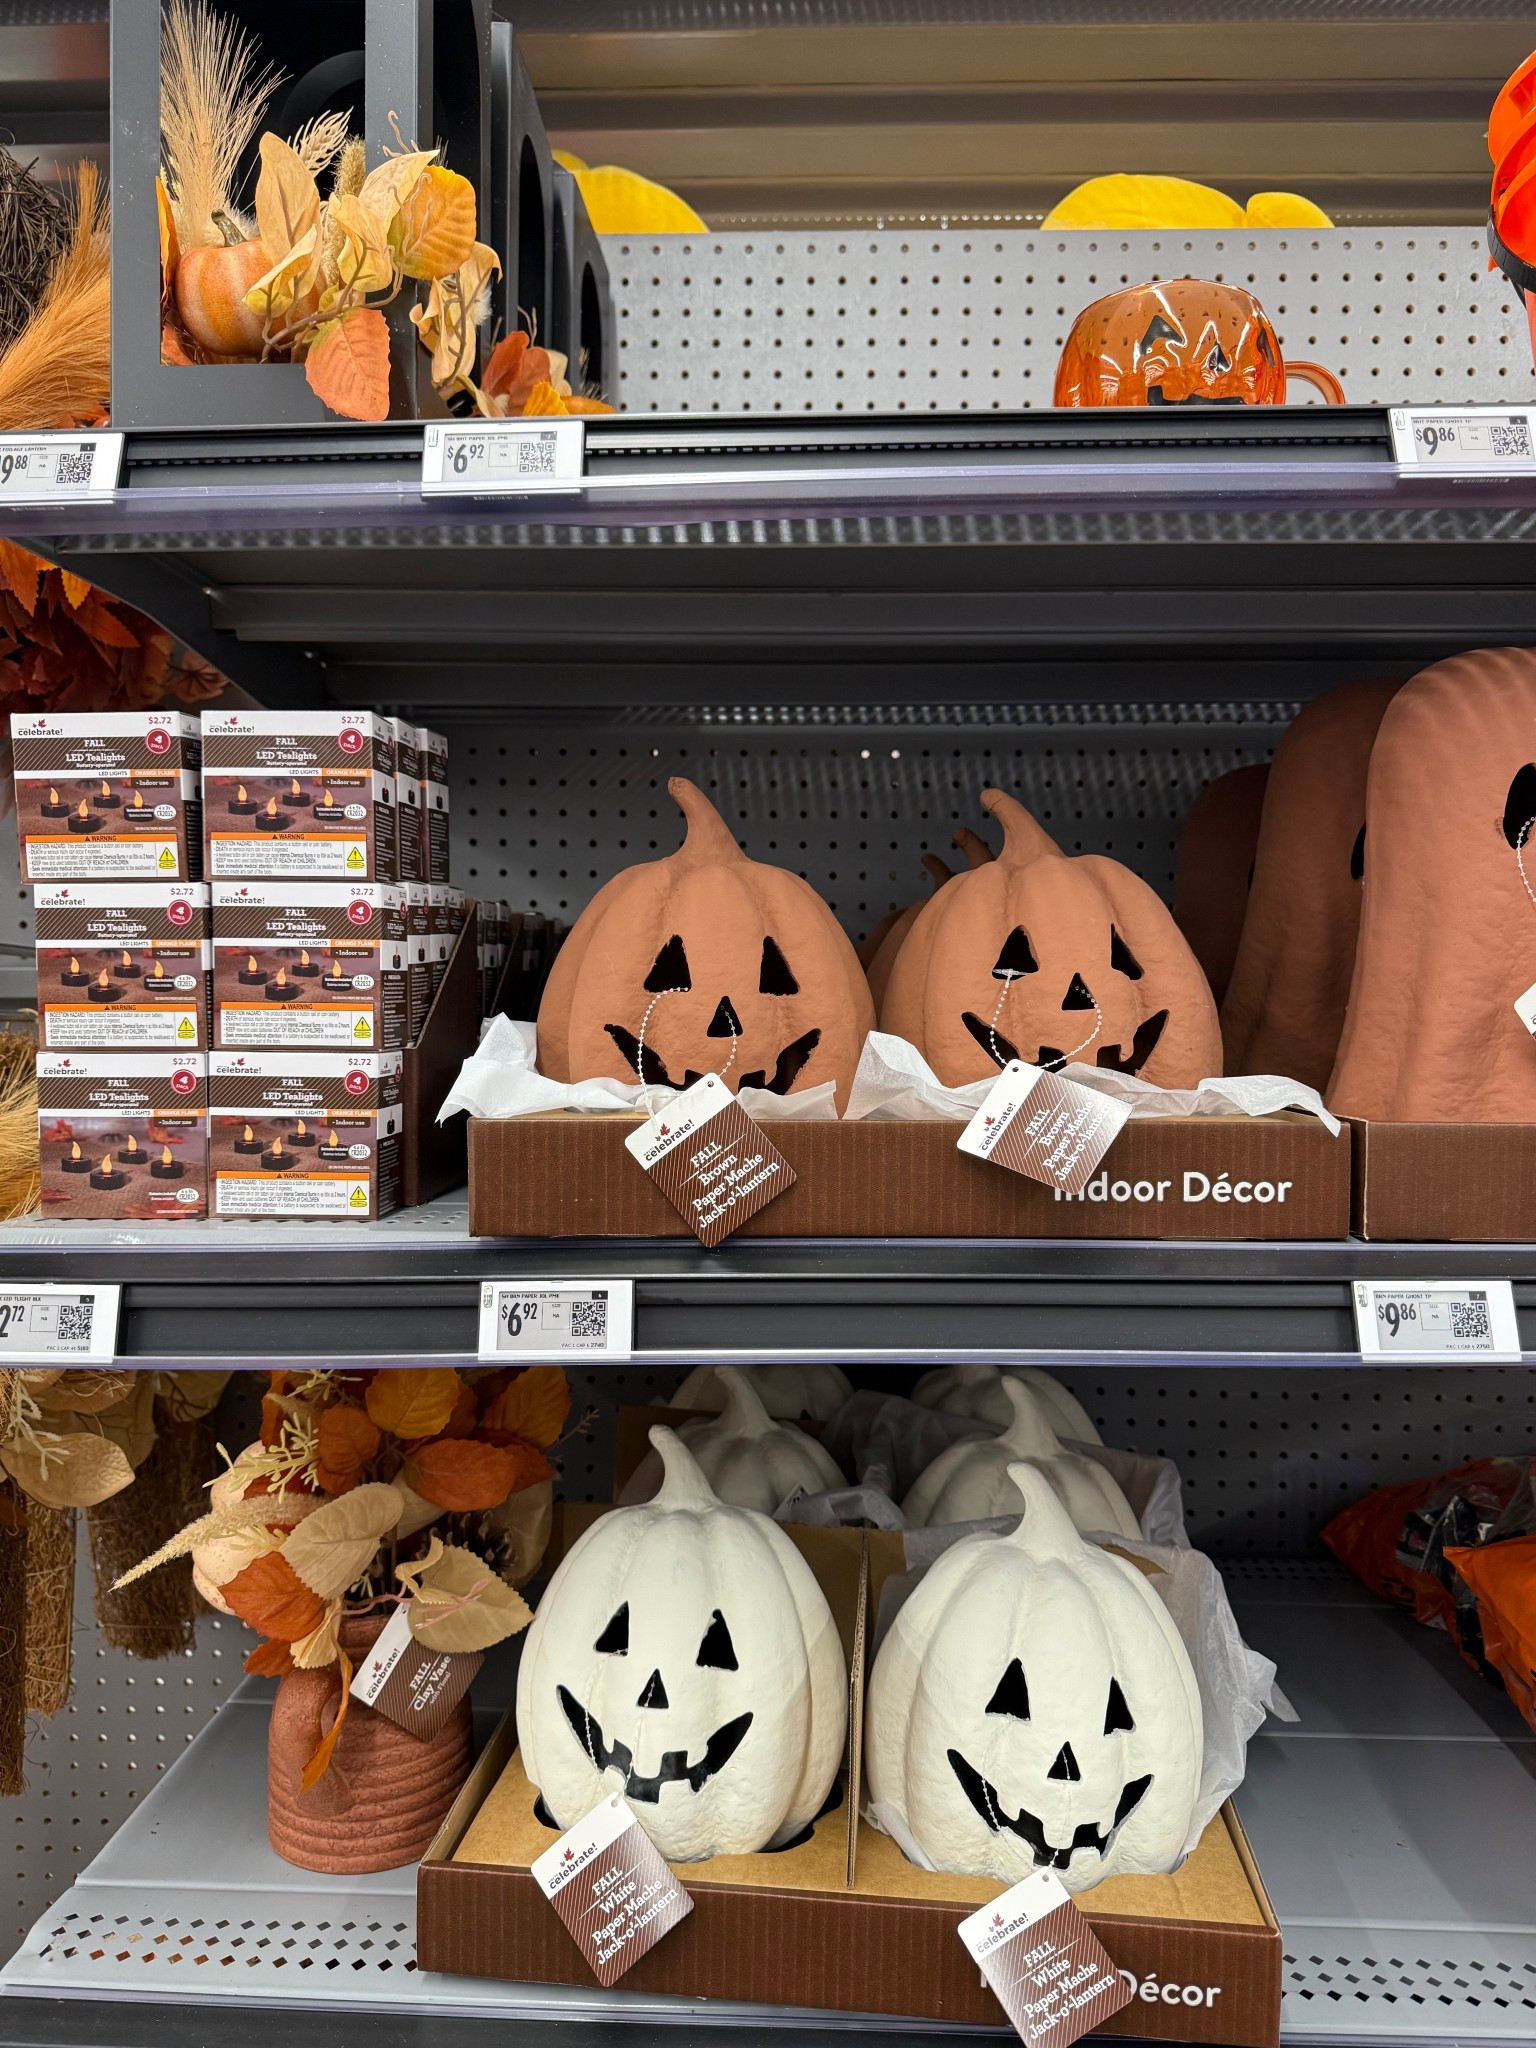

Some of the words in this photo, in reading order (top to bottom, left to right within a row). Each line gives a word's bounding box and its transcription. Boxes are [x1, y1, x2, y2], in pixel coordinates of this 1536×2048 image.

[148, 717, 172, 725] $2.72
[341, 716, 365, 724] $2.72
[17, 728, 63, 736] celebrate!
[84, 739, 106, 747] FALL
[154, 735, 163, 744] 4
[275, 738, 298, 746] FALL
[347, 734, 356, 744] 4
[65, 753, 85, 762] LED
[85, 753, 126, 763] Tealights
[256, 751, 275, 760] LED
[276, 751, 318, 762] Tealights
[170, 888, 194, 896] $2.72
[350, 888, 374, 896] $2.72
[41, 898, 85, 906] celebrate!
[175, 906, 185, 915] 4
[356, 906, 365, 915] 4
[87, 924, 106, 932] LED
[106, 923, 147, 933] Tealights
[266, 922, 285, 930] LED
[286, 922, 327, 932] Tealights
[172, 1058, 197, 1066] $2.72
[348, 1058, 372, 1066] $2.72
[216, 1066, 261, 1074] celebrate!
[107, 1079, 130, 1087] FALL
[179, 1075, 188, 1085] 4
[353, 1076, 362, 1085] 4
[88, 1093, 107, 1101] LED
[108, 1092, 150, 1102] Tealights
[262, 1092, 281, 1100] LED
[282, 1092, 323, 1102] Tealights
[980, 1102, 1017, 1151] celebrate!
[1024, 1109, 1050, 1137] FALL
[1038, 1111, 1070, 1147] Brown
[645, 1118, 695, 1162] celebrate!
[1042, 1136, 1071, 1169] Paper
[1064, 1101, 1095, 1137] Mache
[690, 1141, 722, 1168] FALL
[697, 1154, 738, 1187] Brown
[692, 1180, 727, 1212] Paper
[724, 1153, 764, 1188] Mache
[1183, 1171, 1293, 1203] Décor
[368, 1648, 400, 1699] celebrate!
[409, 1662, 431, 1690] FALL
[413, 1683, 434, 1711] Clay
[430, 1656, 452, 1682] Vase
[430, 1691, 441, 1704] with
[437, 1671, 451, 1691] Floral
[550, 1842, 598, 1890] celebrate!
[591, 1866, 624, 1897] FALL
[598, 1880, 637, 1914] White
[591, 1911, 626, 1945] Paper
[623, 1879, 663, 1918] Mache
[977, 1912, 1030, 1953] celebrate!
[1023, 1940, 1057, 1968] FALL
[1031, 1959, 1071, 1989] White
[1023, 1990, 1059, 2019] Paper
[1057, 1962, 1099, 1994] Mache
